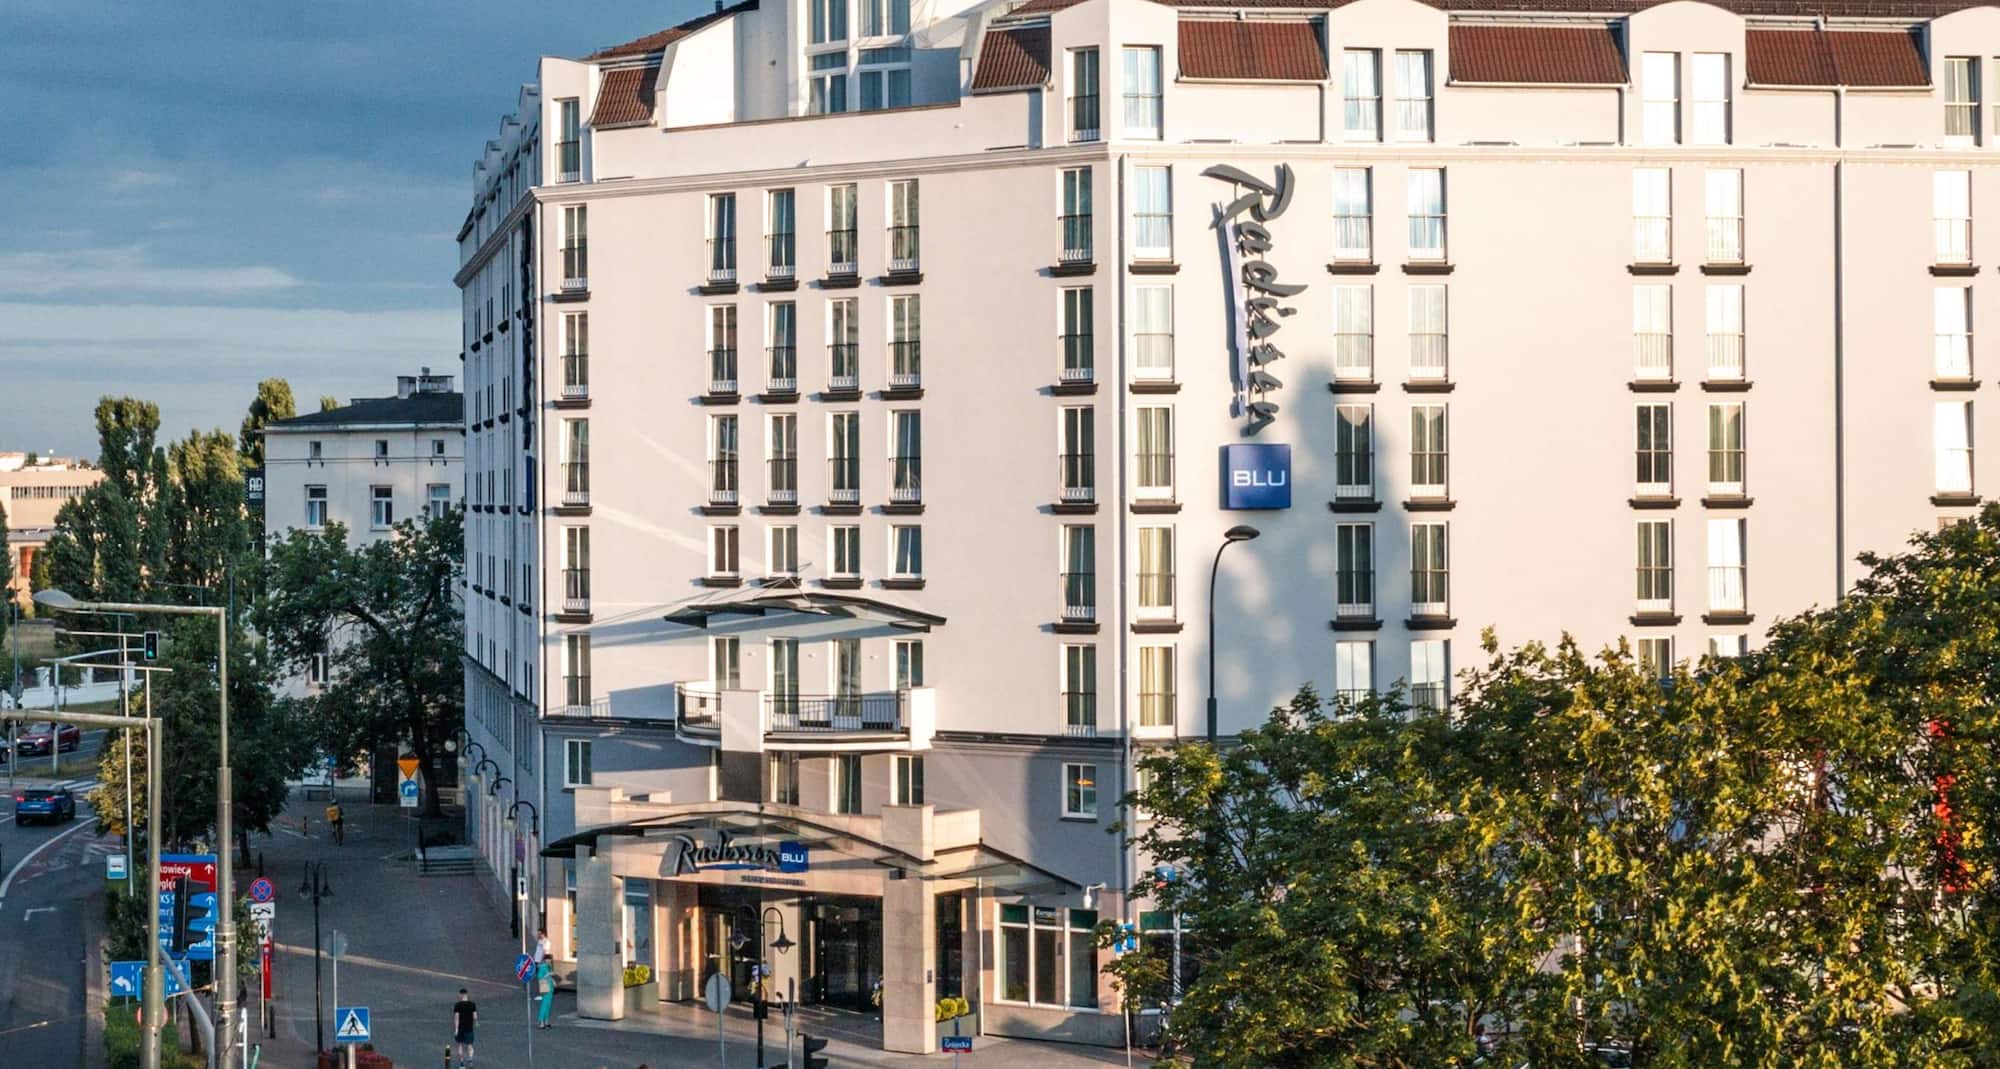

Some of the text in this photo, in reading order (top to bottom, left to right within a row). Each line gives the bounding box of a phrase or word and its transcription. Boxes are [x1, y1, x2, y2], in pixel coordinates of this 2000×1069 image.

[1199, 163, 1308, 437] Radisson
[1233, 470, 1286, 487] BLU
[664, 831, 804, 876] Radisson BLU
